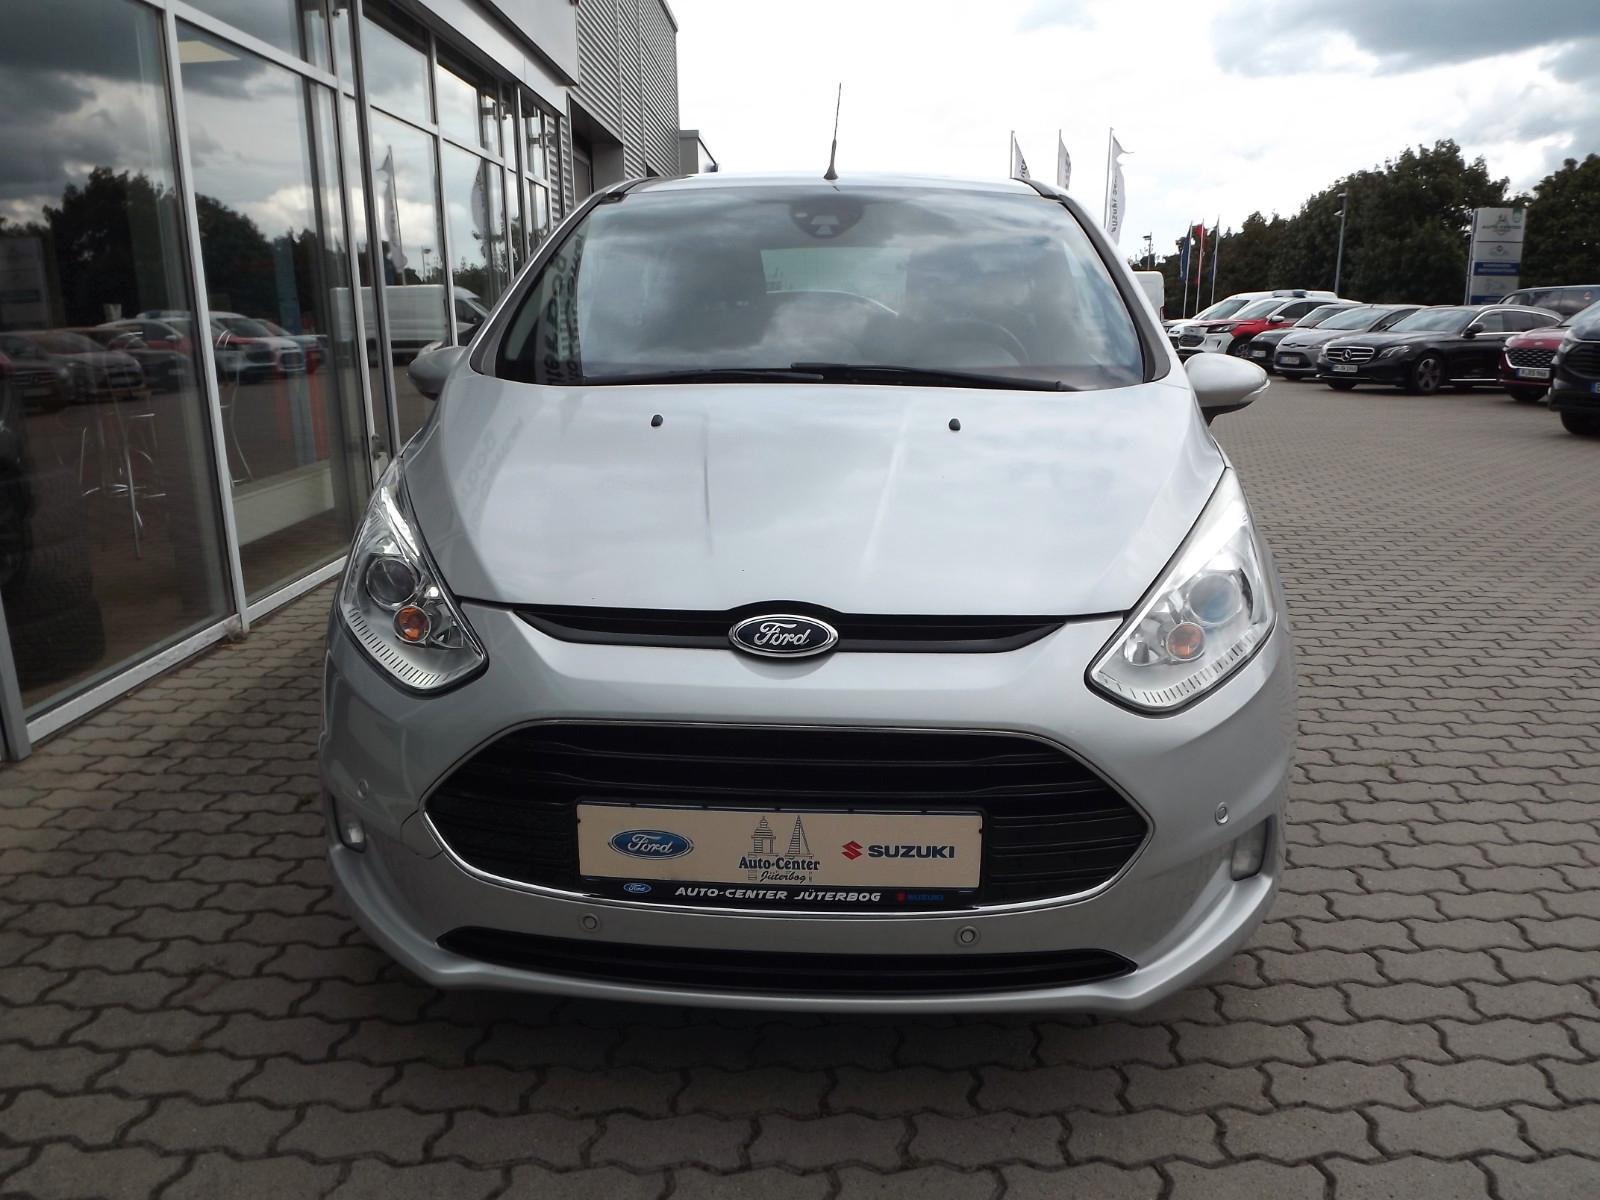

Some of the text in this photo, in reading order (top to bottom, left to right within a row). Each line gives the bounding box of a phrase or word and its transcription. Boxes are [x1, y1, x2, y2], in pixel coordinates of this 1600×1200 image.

[753, 621, 811, 646] Ford
[627, 833, 673, 855] Ford
[868, 844, 956, 859] SUZUKI
[738, 856, 821, 871] Auto-Center
[759, 870, 807, 884] Jüterbog
[675, 886, 881, 903] AUTO-CENTER JÜTERBOG
